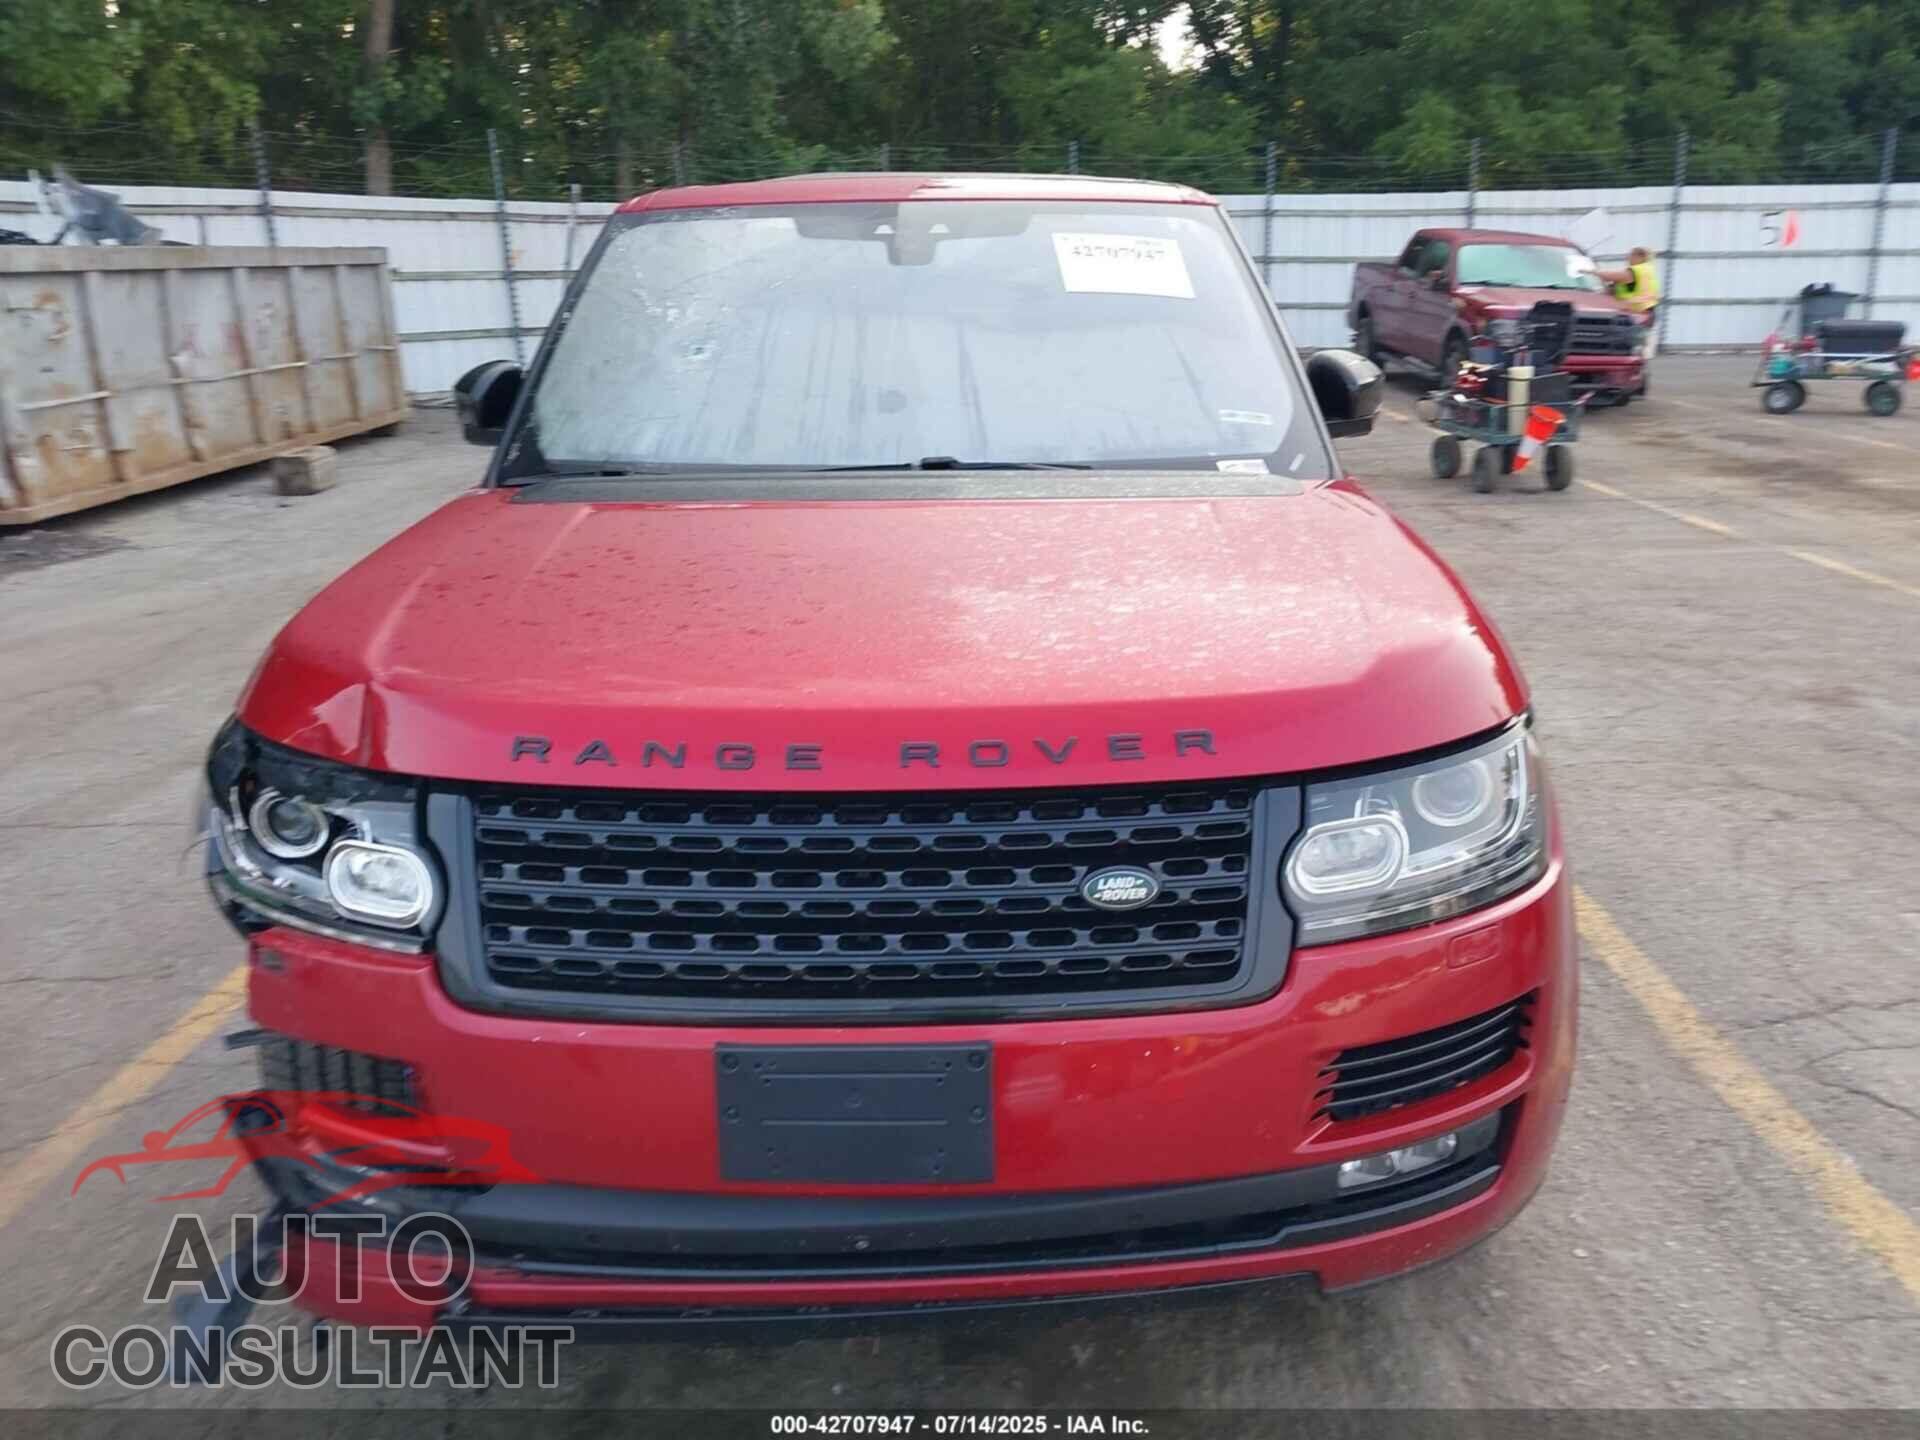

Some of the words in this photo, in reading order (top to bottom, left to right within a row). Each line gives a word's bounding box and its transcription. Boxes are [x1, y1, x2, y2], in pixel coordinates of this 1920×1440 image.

[511, 735, 824, 770] RANGE
[900, 729, 1217, 768] ROVER
[1097, 876, 1136, 890] LAND
[1101, 887, 1148, 901] ROVER
